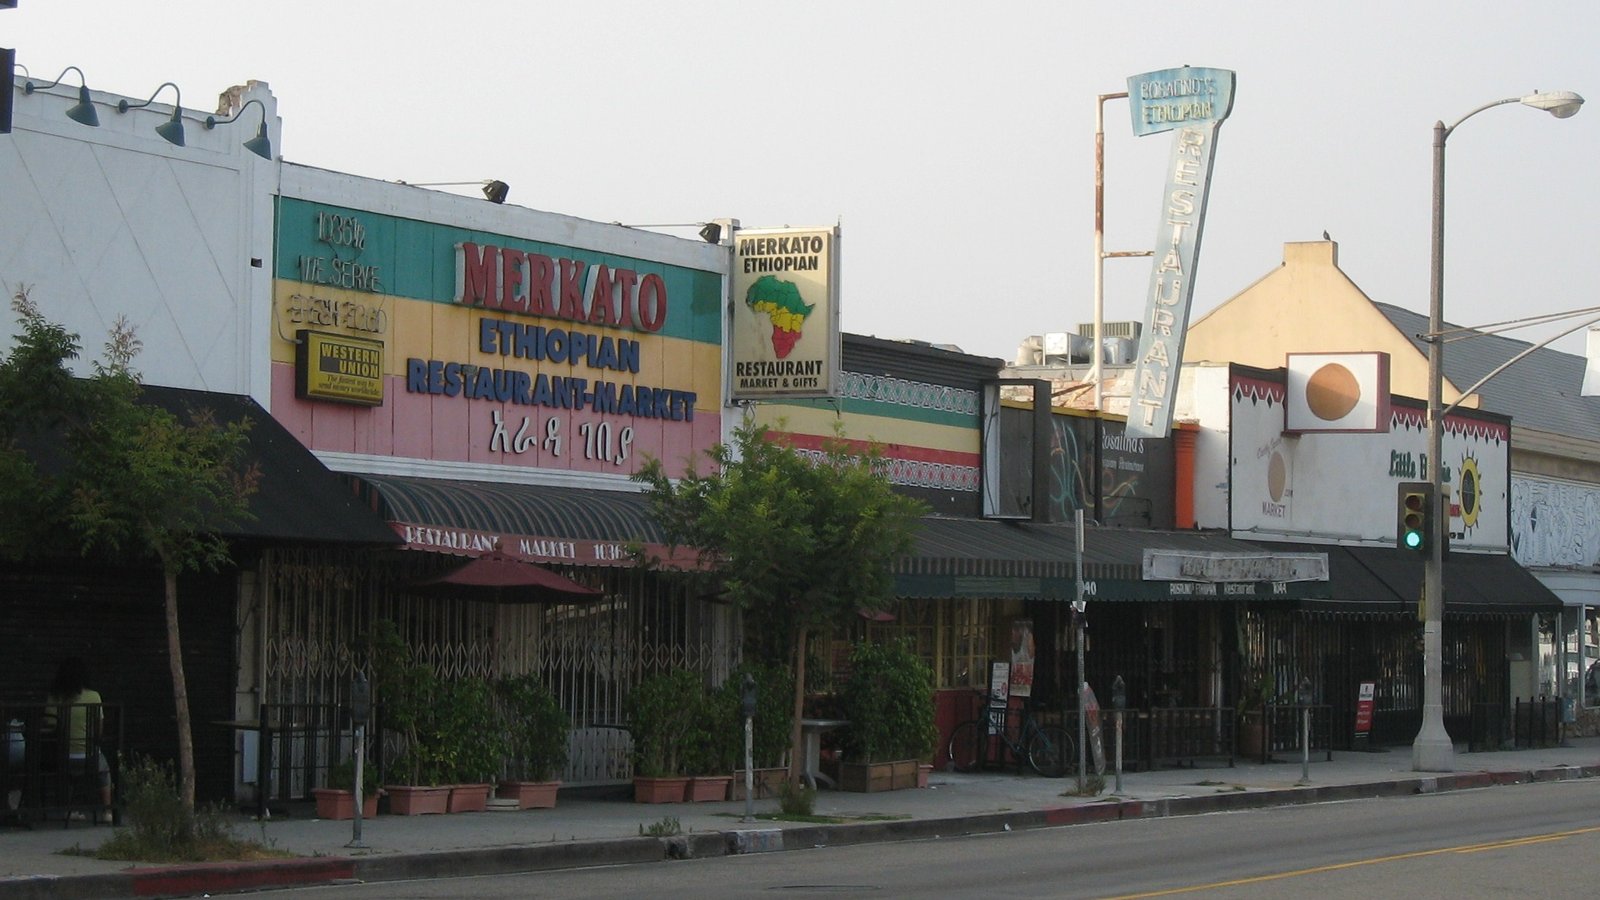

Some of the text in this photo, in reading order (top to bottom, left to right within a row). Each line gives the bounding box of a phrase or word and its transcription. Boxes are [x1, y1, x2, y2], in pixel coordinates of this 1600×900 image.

[1142, 101, 1213, 125] ETHIOPIAN
[739, 235, 824, 257] MERKATO
[330, 258, 382, 293] SERVE
[743, 256, 819, 274] ETHIOPIAN
[455, 241, 667, 332] MERKATO
[1138, 129, 1205, 428] RESTAURANT
[321, 343, 379, 365] WESTERN
[479, 317, 640, 374] ETHIOPIAN
[339, 360, 379, 378] UNION
[736, 360, 823, 377] RESTAURANT
[740, 377, 818, 388] MARKET & GIFTS
[1389, 449, 1417, 479] Little
[1262, 501, 1286, 519] MARKET
[405, 526, 499, 551] RESTAURANT
[519, 539, 577, 559] MARKET
